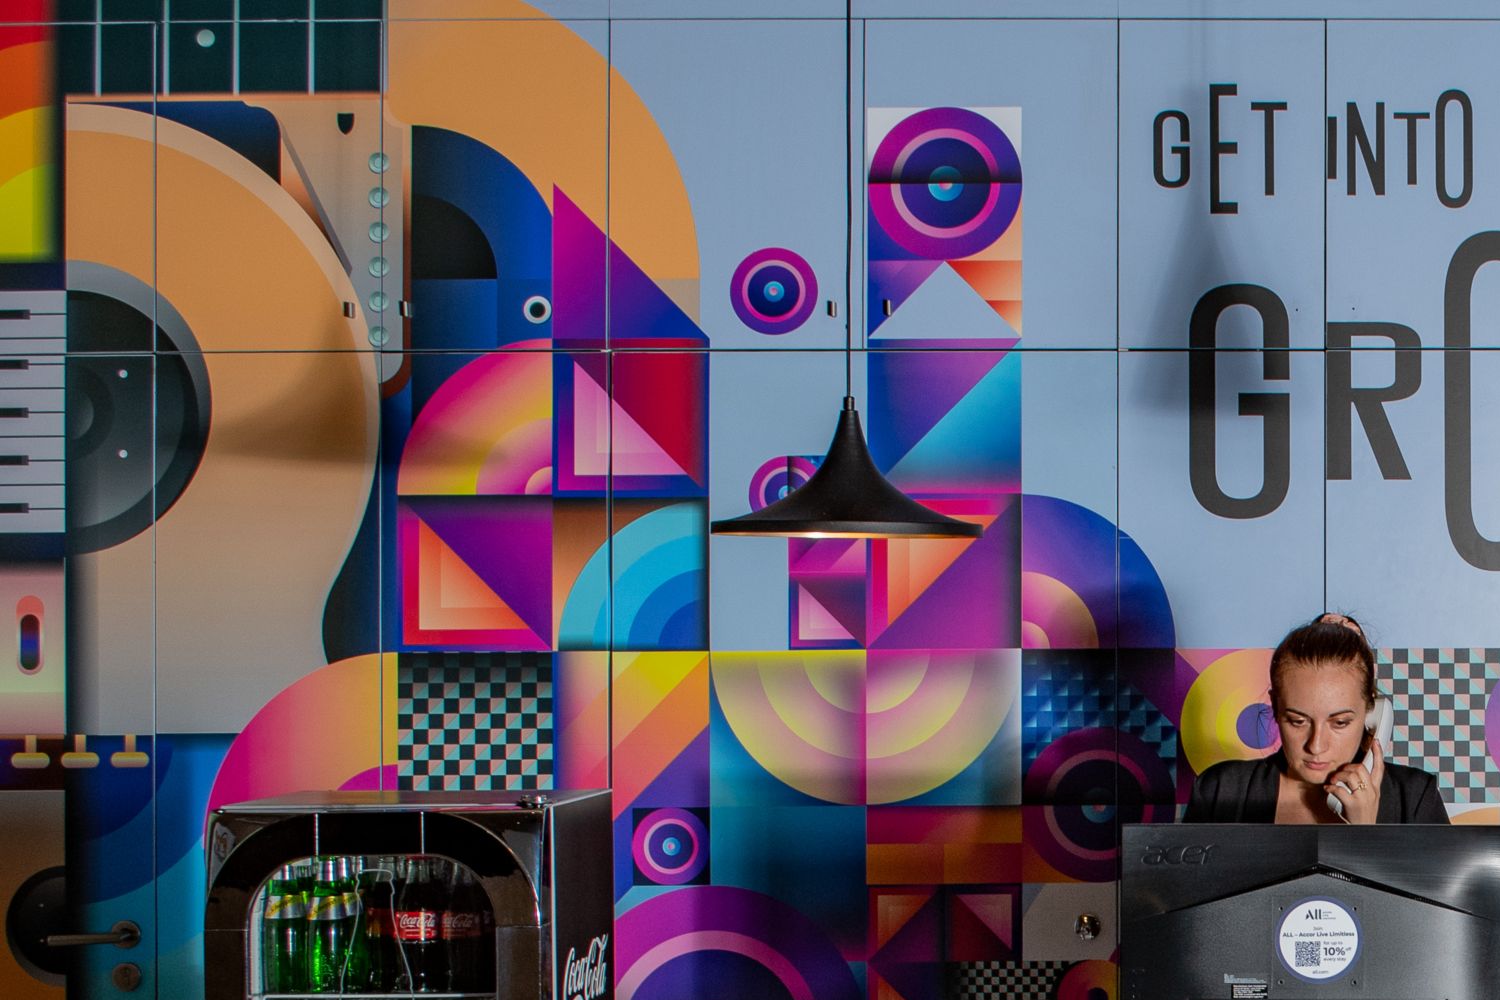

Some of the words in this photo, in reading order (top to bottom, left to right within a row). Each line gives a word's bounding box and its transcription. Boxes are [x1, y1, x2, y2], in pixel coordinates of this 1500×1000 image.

[1152, 83, 1287, 214] GET
[1326, 88, 1473, 209] INTO
[1141, 846, 1216, 865] acer
[1305, 908, 1322, 920] All
[1323, 947, 1345, 956] 10%
